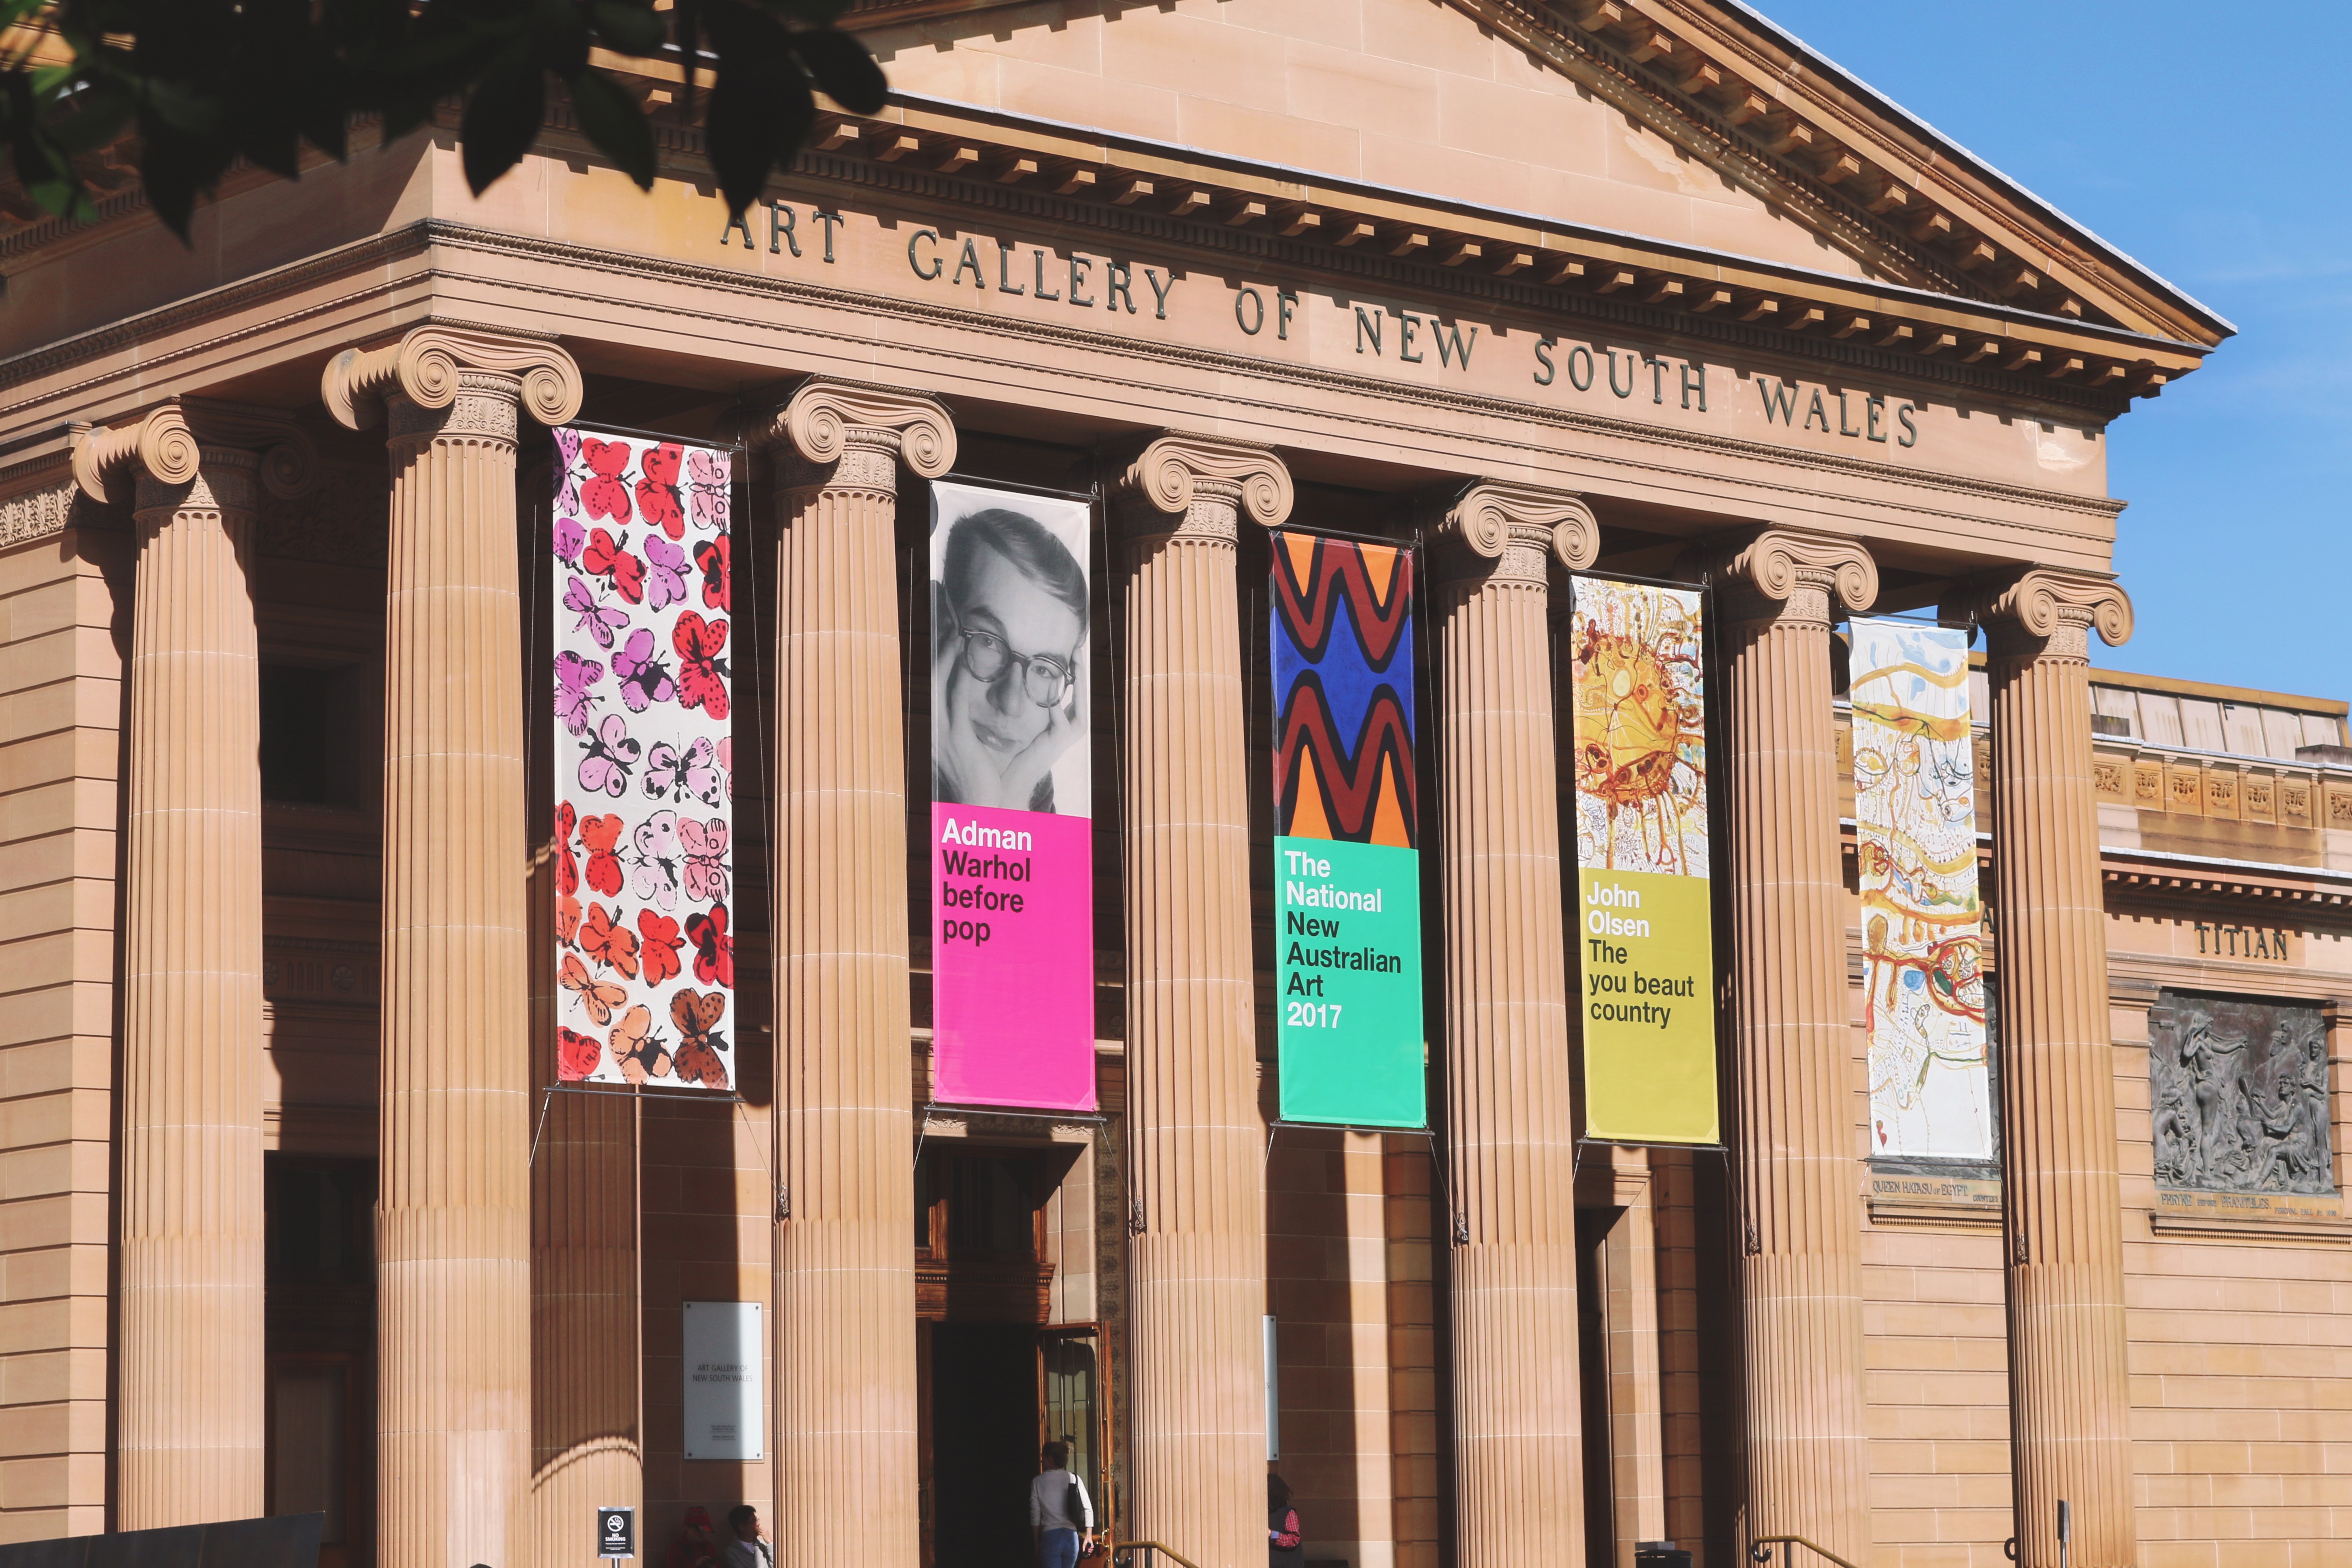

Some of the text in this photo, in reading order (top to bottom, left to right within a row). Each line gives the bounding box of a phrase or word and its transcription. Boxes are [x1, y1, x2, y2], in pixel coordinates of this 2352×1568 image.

[720, 204, 1918, 447] ART GALLERY OF NEW SOUTH WALES
[941, 818, 1032, 851] Adman
[942, 849, 1031, 882] Warhol
[1284, 851, 1331, 877] The
[943, 881, 1024, 913] before
[1286, 880, 1382, 912] National
[1587, 881, 1640, 908] John
[943, 919, 991, 947] pop
[1287, 911, 1340, 938] New
[1588, 910, 1650, 937] Olsen
[1588, 939, 1628, 964] The
[2194, 925, 2287, 960] TITIAN
[1286, 941, 1401, 974] Australian
[1286, 972, 1324, 998] Art
[1589, 971, 1694, 998] you beaut
[1287, 1001, 1342, 1028] 2017
[1590, 1002, 1671, 1030] country
[1873, 1180, 1901, 1194] QUEEN
[1903, 1181, 1933, 1195] HATASU
[2161, 1193, 2192, 1206] PHRYNE
